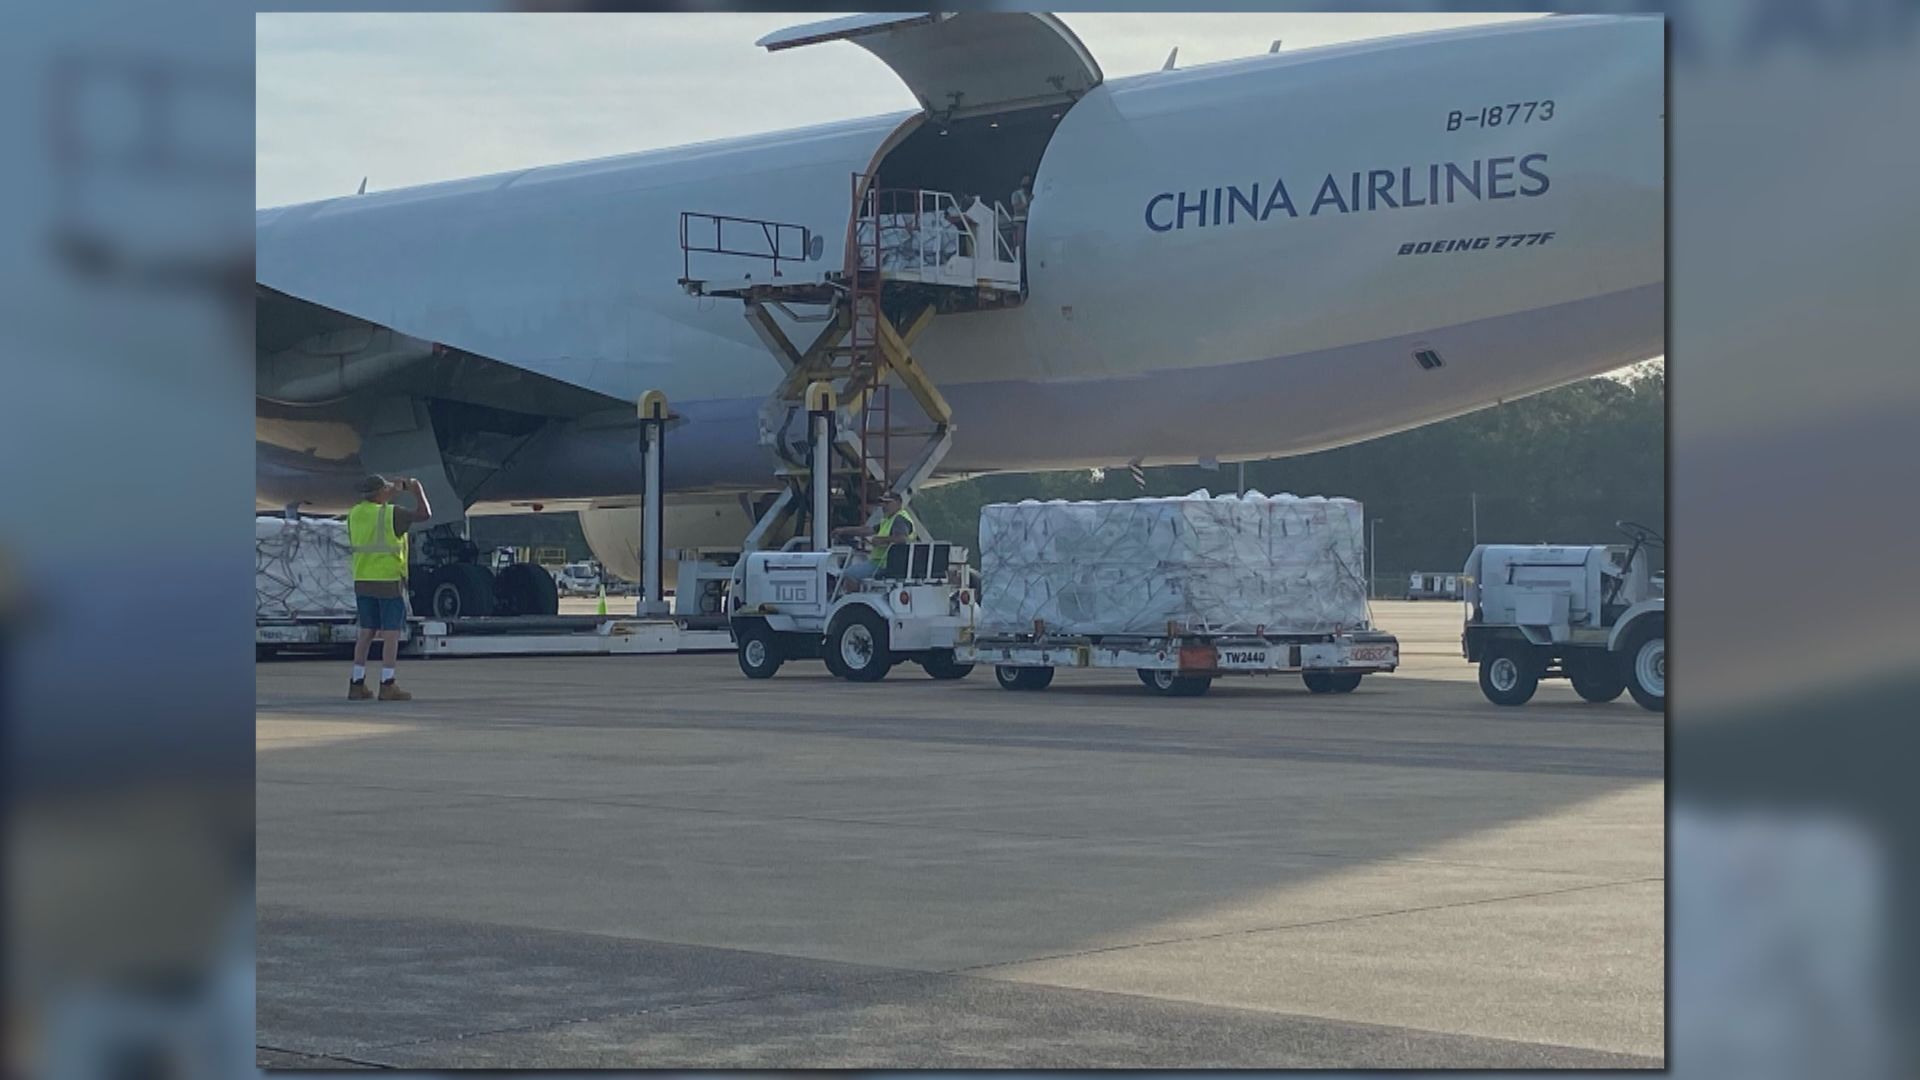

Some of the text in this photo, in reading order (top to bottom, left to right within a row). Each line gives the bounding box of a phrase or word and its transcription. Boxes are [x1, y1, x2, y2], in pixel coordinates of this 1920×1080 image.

[1446, 100, 1556, 132] B-18773
[1144, 153, 1551, 233] CHINA AIRLINES
[1397, 231, 1556, 256] BOEING 777F
[770, 580, 807, 601] TUG
